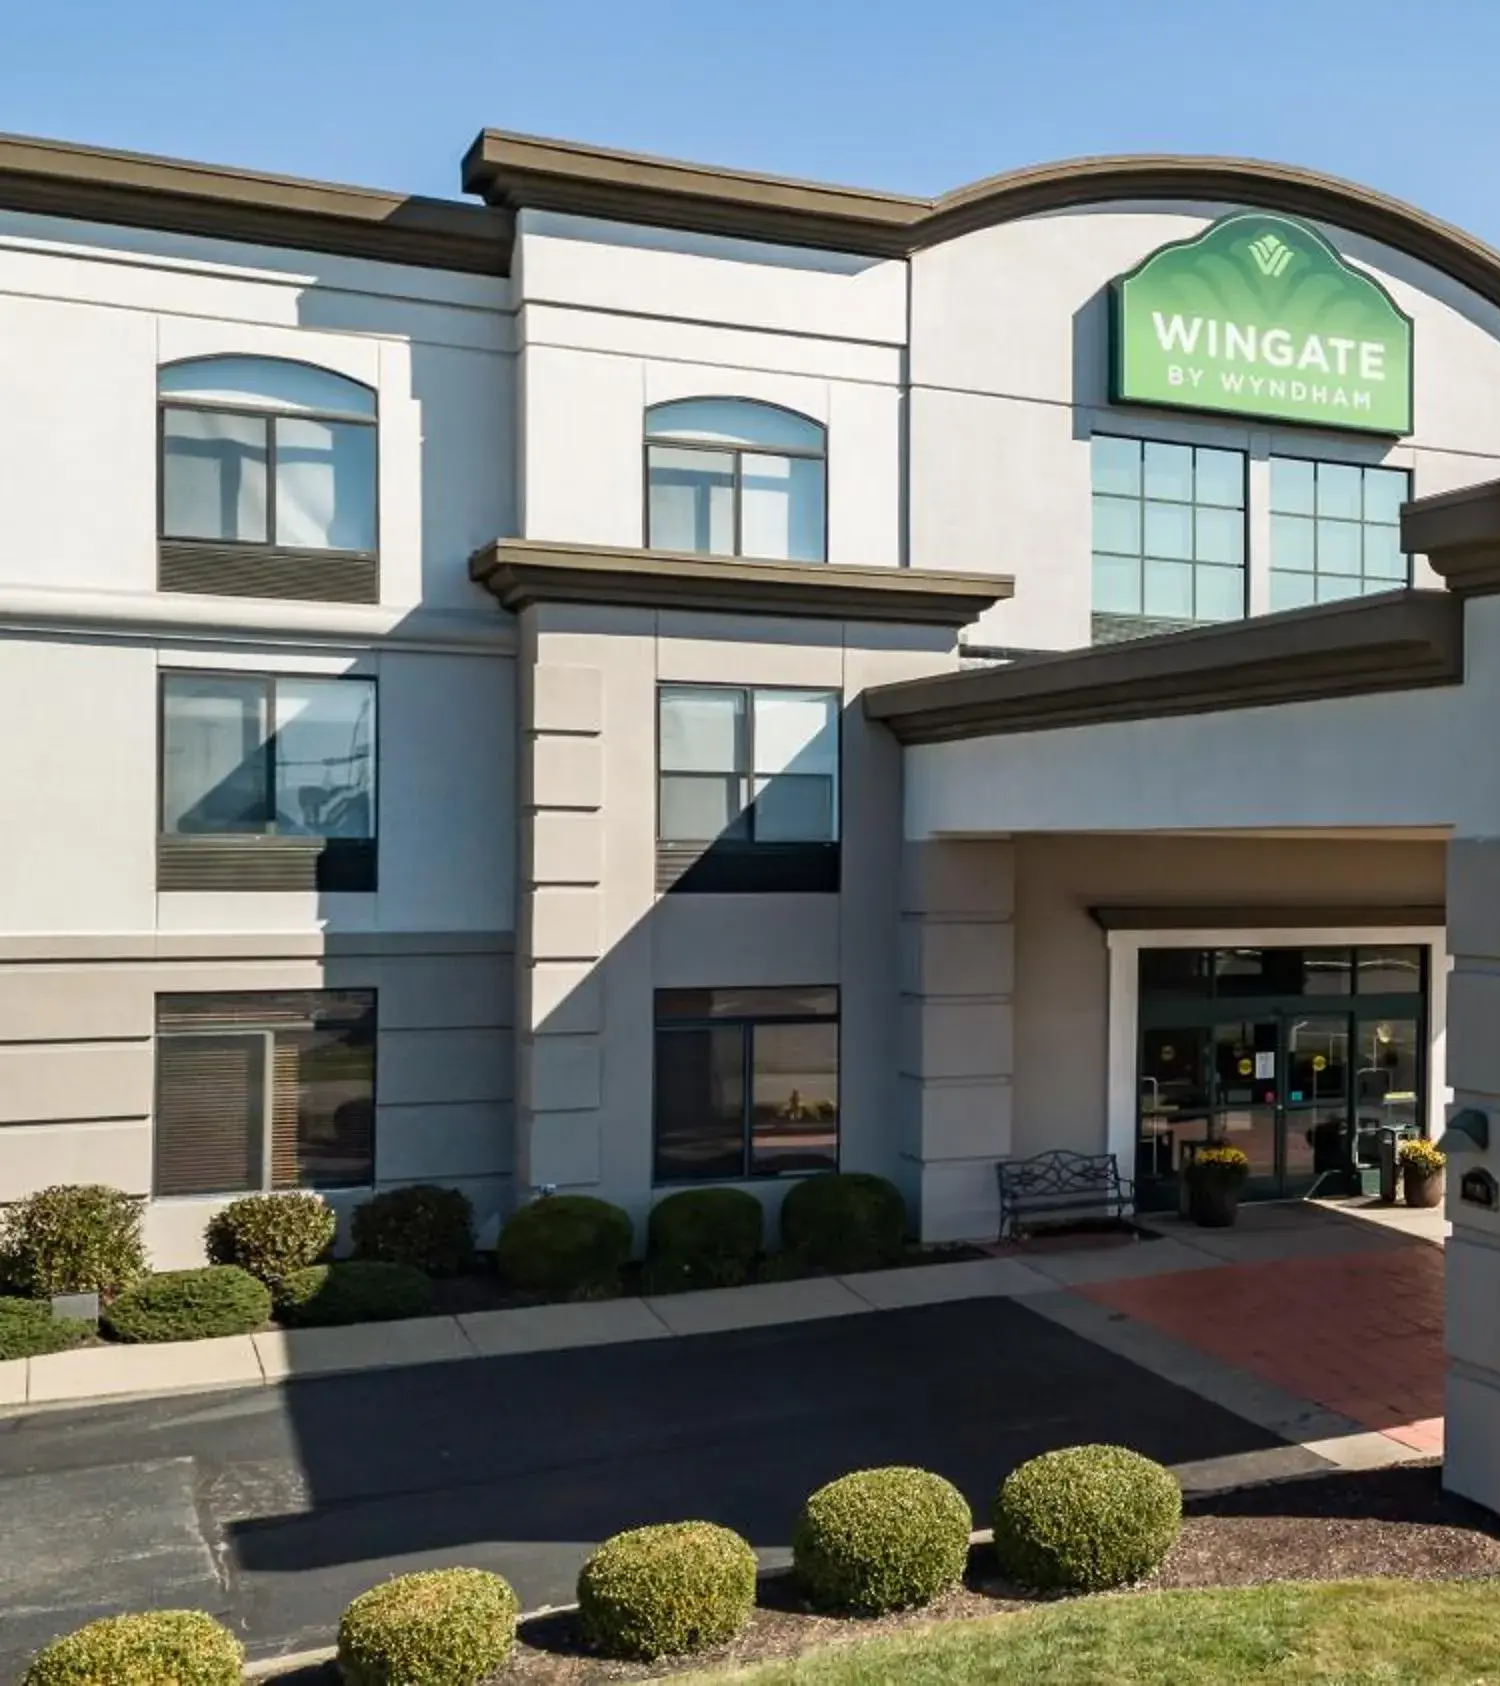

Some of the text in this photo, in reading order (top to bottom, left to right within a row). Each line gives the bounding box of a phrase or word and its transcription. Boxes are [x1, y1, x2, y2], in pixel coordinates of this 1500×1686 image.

[1152, 311, 1386, 380] WINGATE
[1168, 364, 1371, 410] BY WYNDHAM
